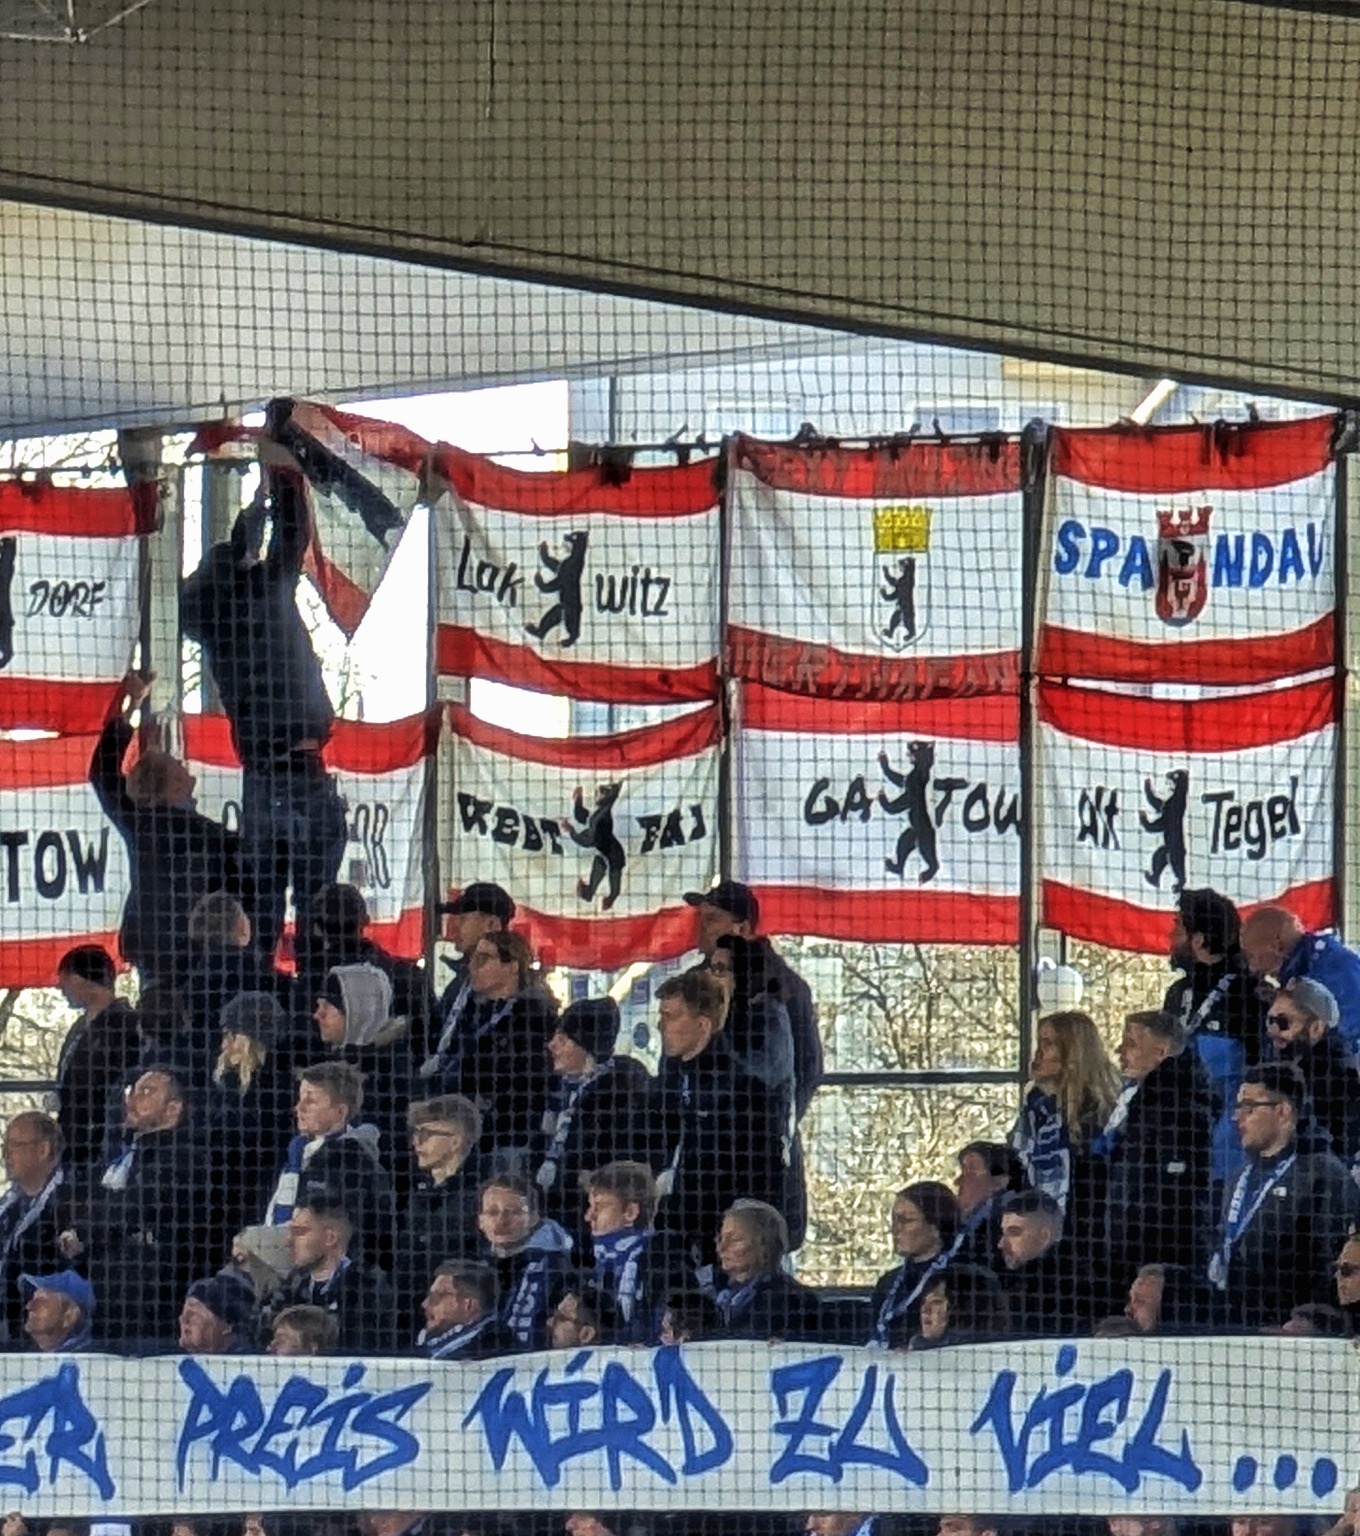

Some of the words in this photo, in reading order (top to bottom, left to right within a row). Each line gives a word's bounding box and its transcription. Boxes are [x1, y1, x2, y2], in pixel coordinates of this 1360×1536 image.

[1054, 519, 1155, 590] SPA
[1212, 521, 1325, 590] NDAU
[27, 579, 107, 619] DORF
[803, 776, 880, 826] GA
[1201, 775, 1301, 859] Tegel
[0, 826, 110, 901] TOW
[176, 1357, 433, 1493] PREIS
[464, 1346, 735, 1493] WIRD
[768, 1355, 928, 1488] ZU
